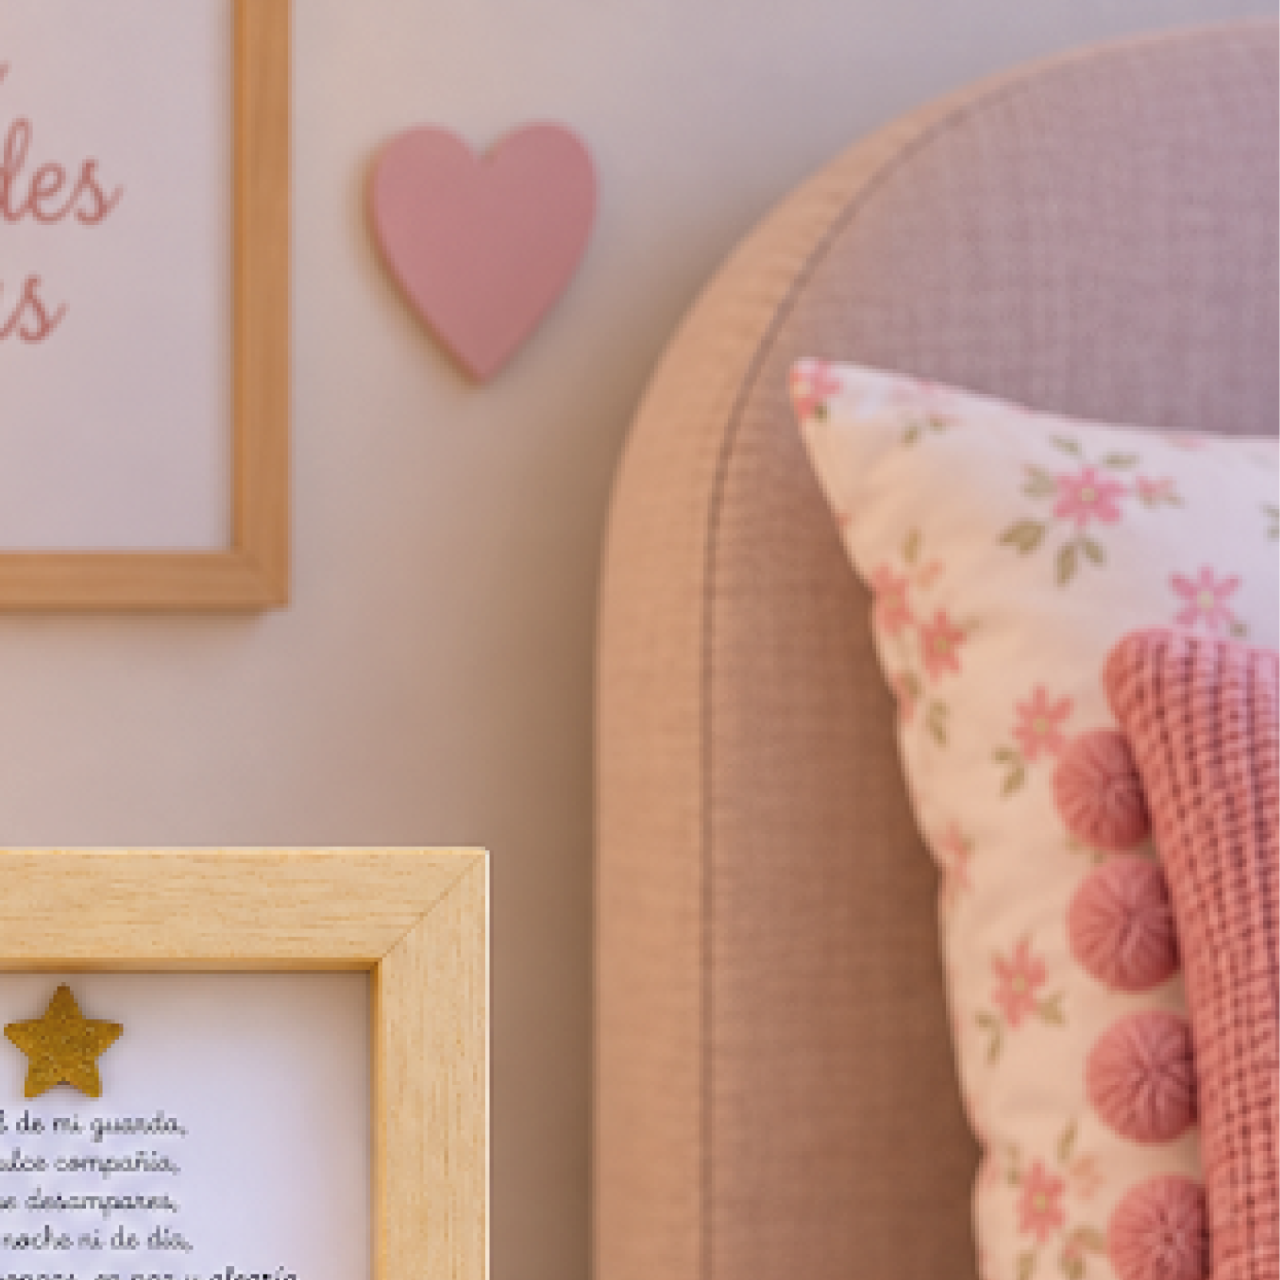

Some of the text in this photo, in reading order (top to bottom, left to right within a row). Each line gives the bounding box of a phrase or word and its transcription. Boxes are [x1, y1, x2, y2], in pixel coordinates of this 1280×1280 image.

[15, 1109, 46, 1135] de
[52, 1112, 82, 1135] mi
[90, 1109, 187, 1143] guarda,
[24, 1186, 180, 1219] desampares,
[3, 1224, 74, 1251] noche
[77, 1228, 105, 1251] ni
[110, 1224, 141, 1251] de
[147, 1224, 194, 1254] día,
